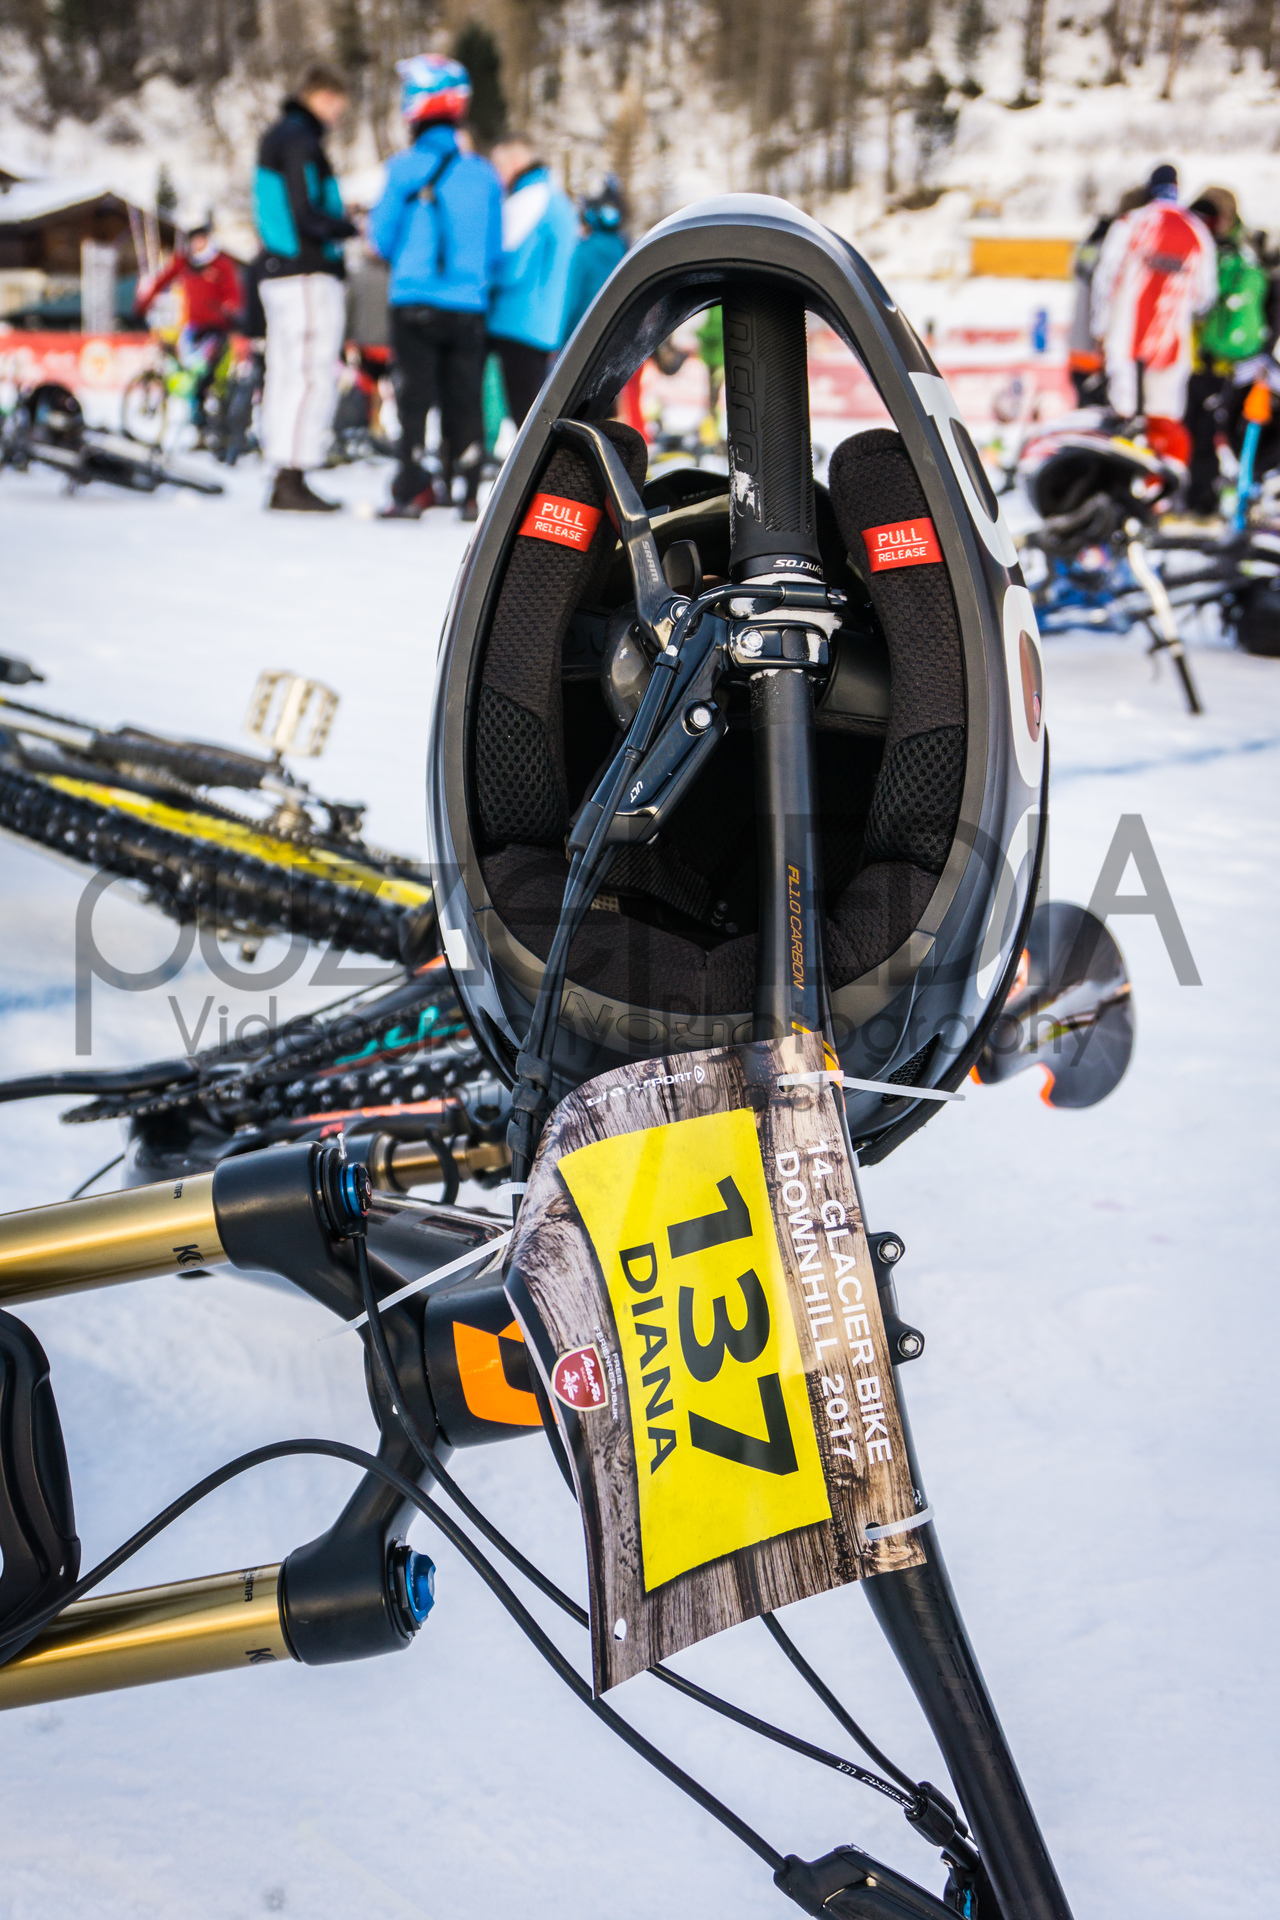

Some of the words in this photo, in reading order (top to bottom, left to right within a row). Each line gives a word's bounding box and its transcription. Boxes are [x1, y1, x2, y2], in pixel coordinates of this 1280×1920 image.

[534, 521, 583, 543] RELEASE
[541, 502, 585, 527] PULL
[876, 526, 923, 547] PULL
[877, 546, 928, 563] RELEASE
[641, 540, 661, 582] SRAM
[788, 914, 805, 990] CARBON
[667, 1174, 799, 1477] 137
[775, 1150, 839, 1362] DOWNHILL
[819, 1372, 858, 1461] 2017
[819, 1198, 876, 1366] GLACIER
[856, 1377, 892, 1465] BIKE
[593, 1325, 617, 1420] FERIENREPUBLIK
[612, 1353, 623, 1385] FREIE
[618, 1242, 677, 1476] DIANA
[838, 1761, 857, 1776] LEX
